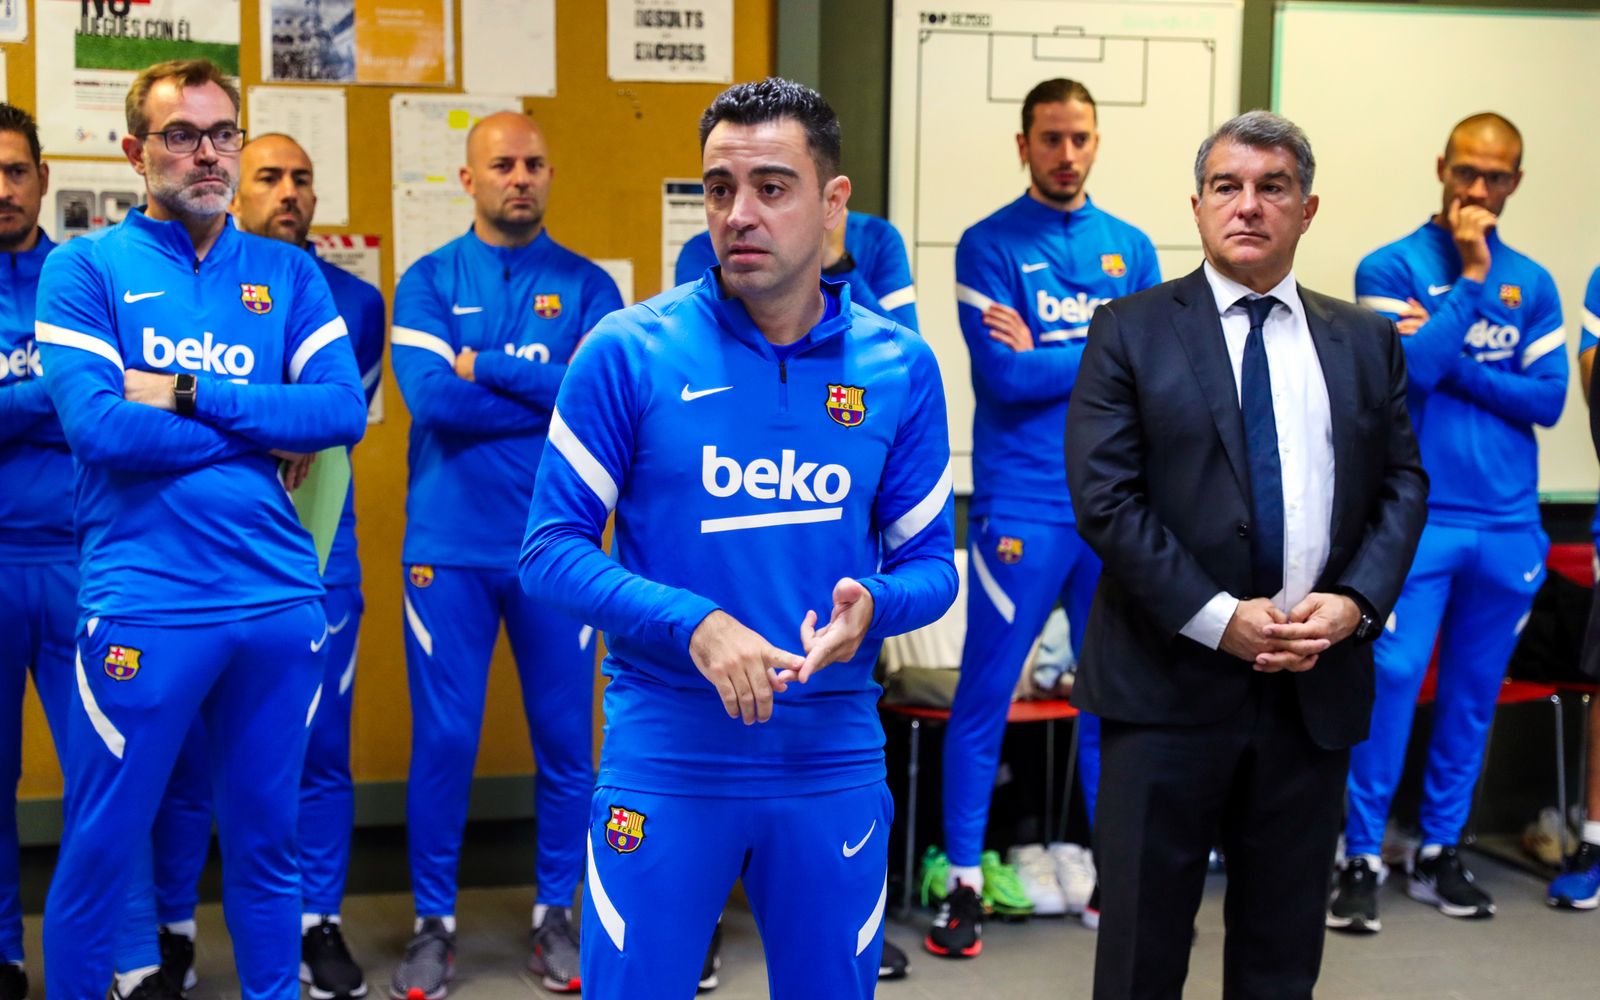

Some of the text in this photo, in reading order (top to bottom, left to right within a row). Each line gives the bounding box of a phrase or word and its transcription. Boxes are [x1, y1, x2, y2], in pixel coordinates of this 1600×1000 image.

[1036, 290, 1112, 323] bek
[143, 327, 255, 376] beko
[702, 445, 851, 503] beko
